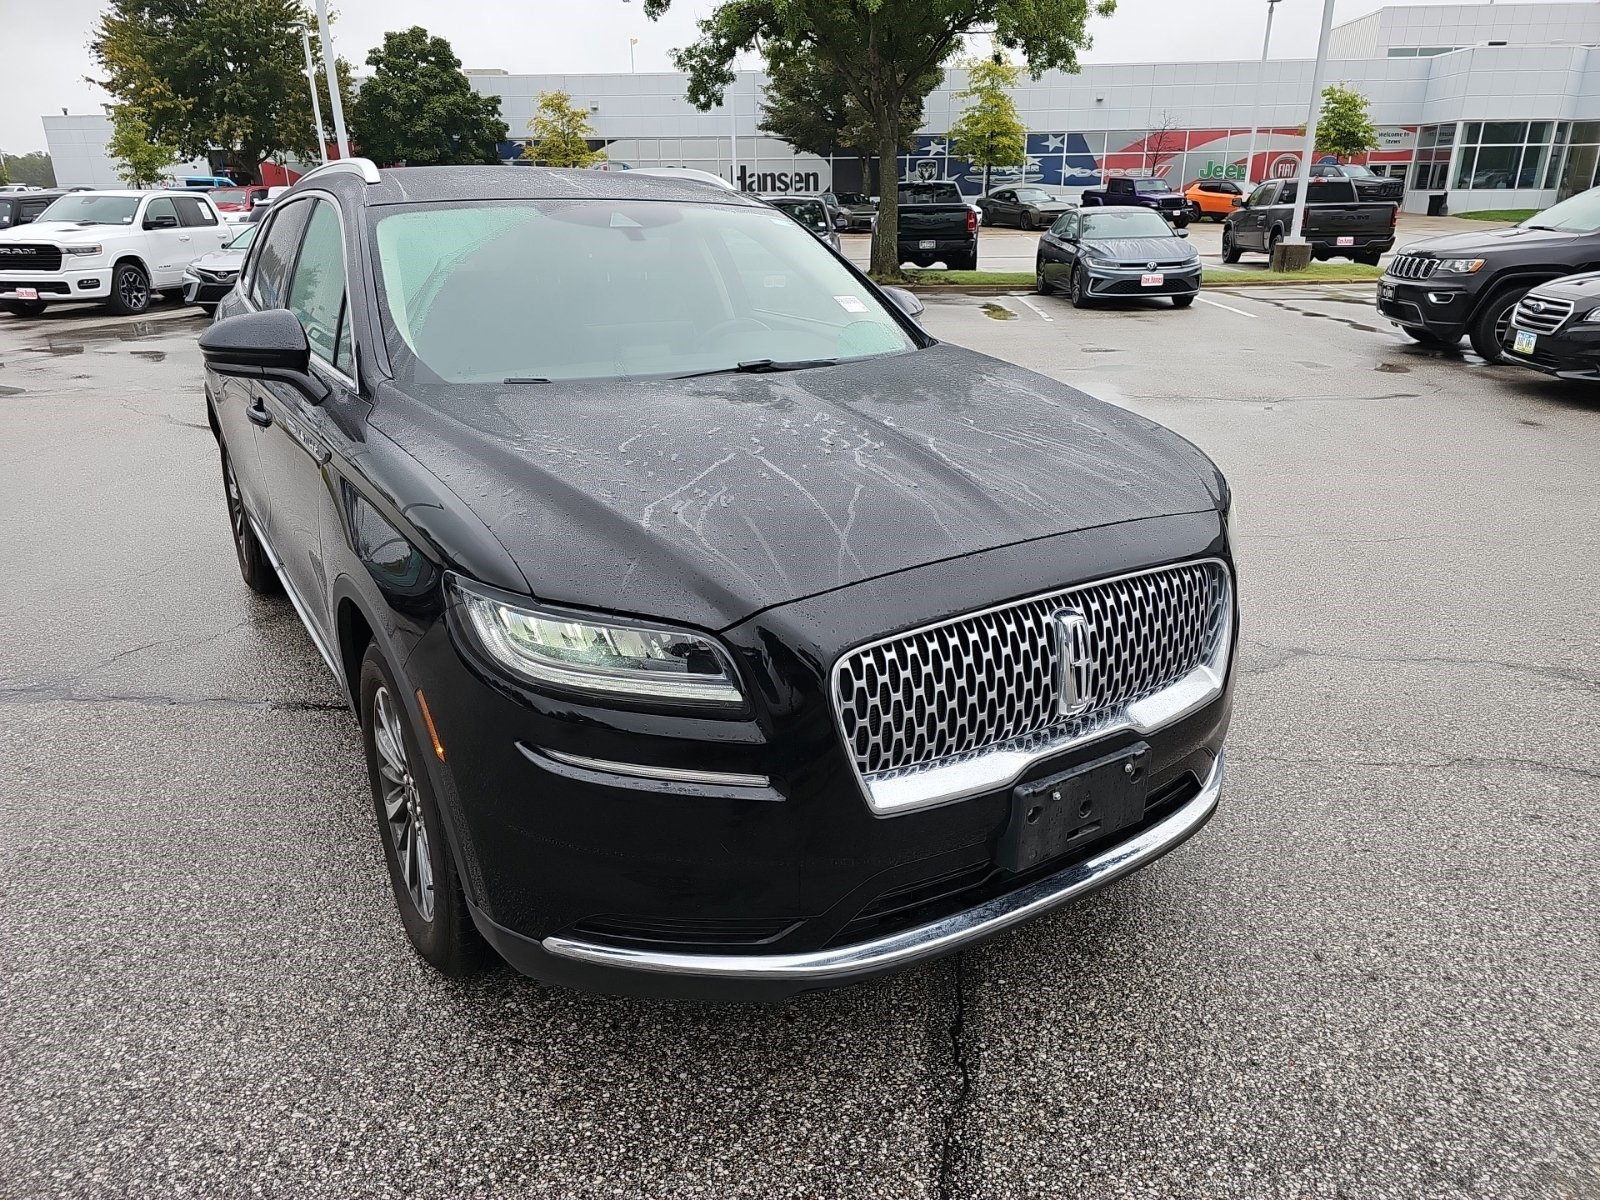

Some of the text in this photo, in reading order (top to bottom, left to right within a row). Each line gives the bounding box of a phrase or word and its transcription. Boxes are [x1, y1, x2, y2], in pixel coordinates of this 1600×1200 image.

[730, 165, 819, 192] Hansen
[1199, 160, 1248, 180] Jeep
[1278, 163, 1296, 177] FIAT
